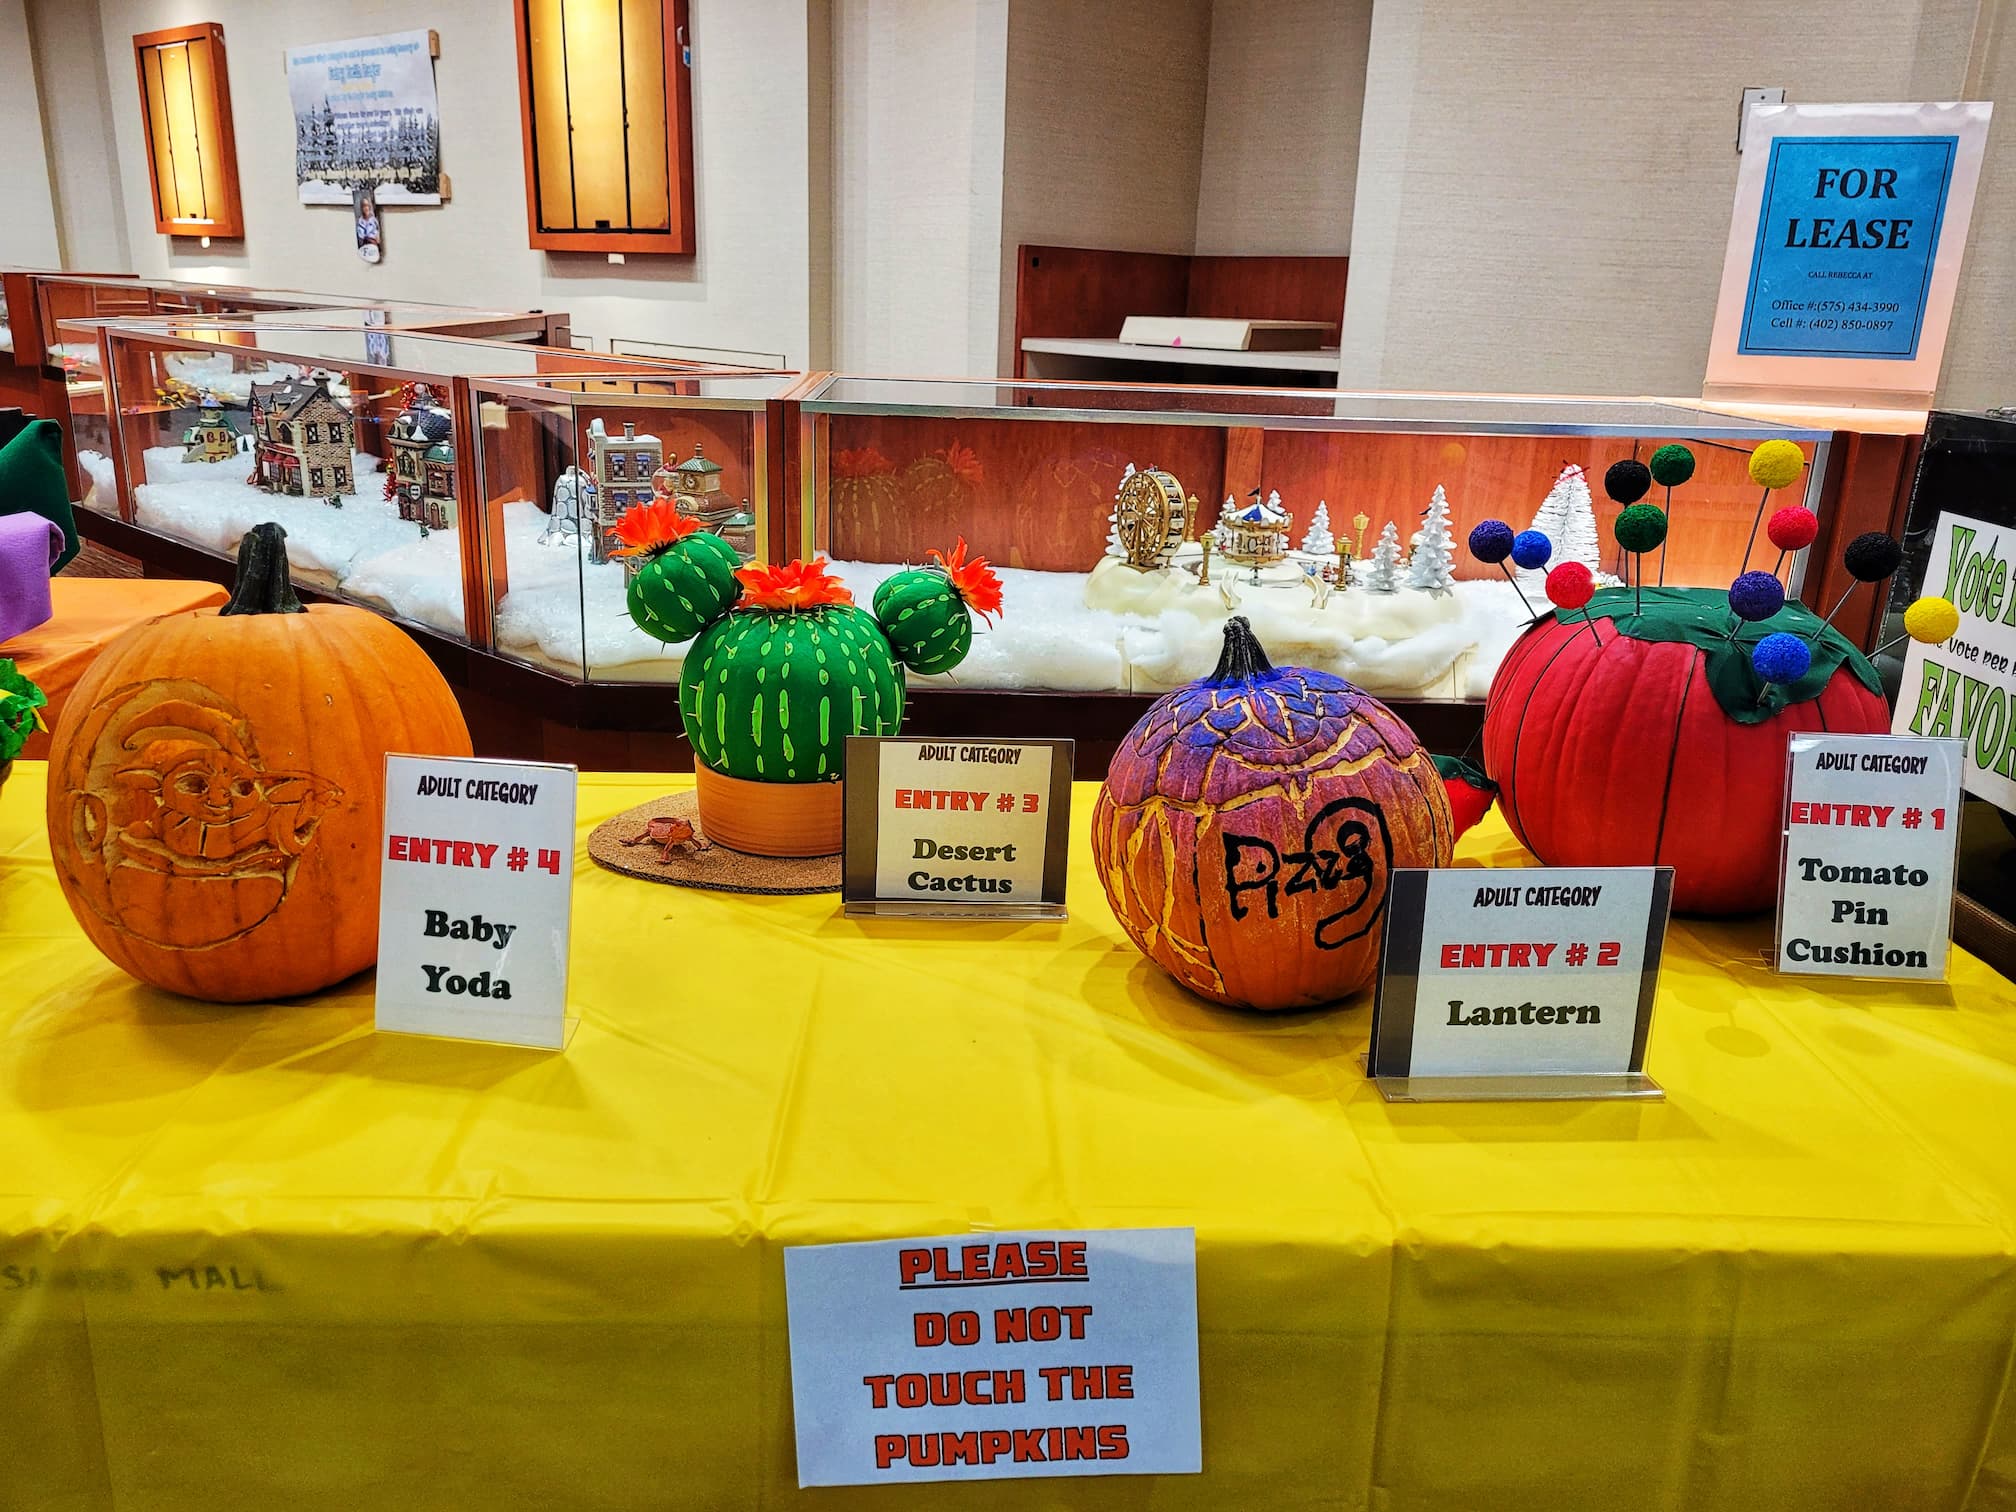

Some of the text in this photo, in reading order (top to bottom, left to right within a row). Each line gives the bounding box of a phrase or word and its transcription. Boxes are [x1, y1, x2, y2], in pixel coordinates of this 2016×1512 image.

[1814, 168, 1898, 199] FOR
[1784, 218, 1913, 249] LEASE
[1808, 271, 1826, 279] CALL
[1828, 271, 1861, 279] REBECCA
[1771, 300, 1804, 311] Office
[1848, 302, 1900, 313] 434-3990
[1771, 318, 1894, 331] Cell #: (402) 850-0897
[1942, 524, 2007, 622] Vote
[918, 744, 1022, 765] ADULT CATEGORY
[1815, 752, 1929, 774] ADULT CATEGORY
[417, 775, 538, 805] ADULT CATEGORY
[895, 789, 1040, 813] ENTRY # 3
[1790, 801, 1946, 831] ENTRY # 1
[388, 835, 561, 875] ENTRY # 4
[912, 838, 1016, 862] Desert
[908, 871, 1013, 894] Cactus
[1798, 857, 1929, 887] Tomato
[1473, 885, 1602, 908] ADULT CATEGORY
[1831, 900, 1889, 925] Pin
[423, 909, 517, 950] Baby
[1440, 941, 1621, 969] ENTRY # 2
[1786, 938, 1928, 968] Cushion
[421, 965, 512, 1000] Yoda
[1446, 1000, 1601, 1026] Lantern
[899, 1241, 1088, 1284] PLEASE
[913, 1305, 1093, 1348] DO NOT
[863, 1365, 1134, 1409] TOUCH THE
[874, 1424, 1130, 1469] PUMPKINS
